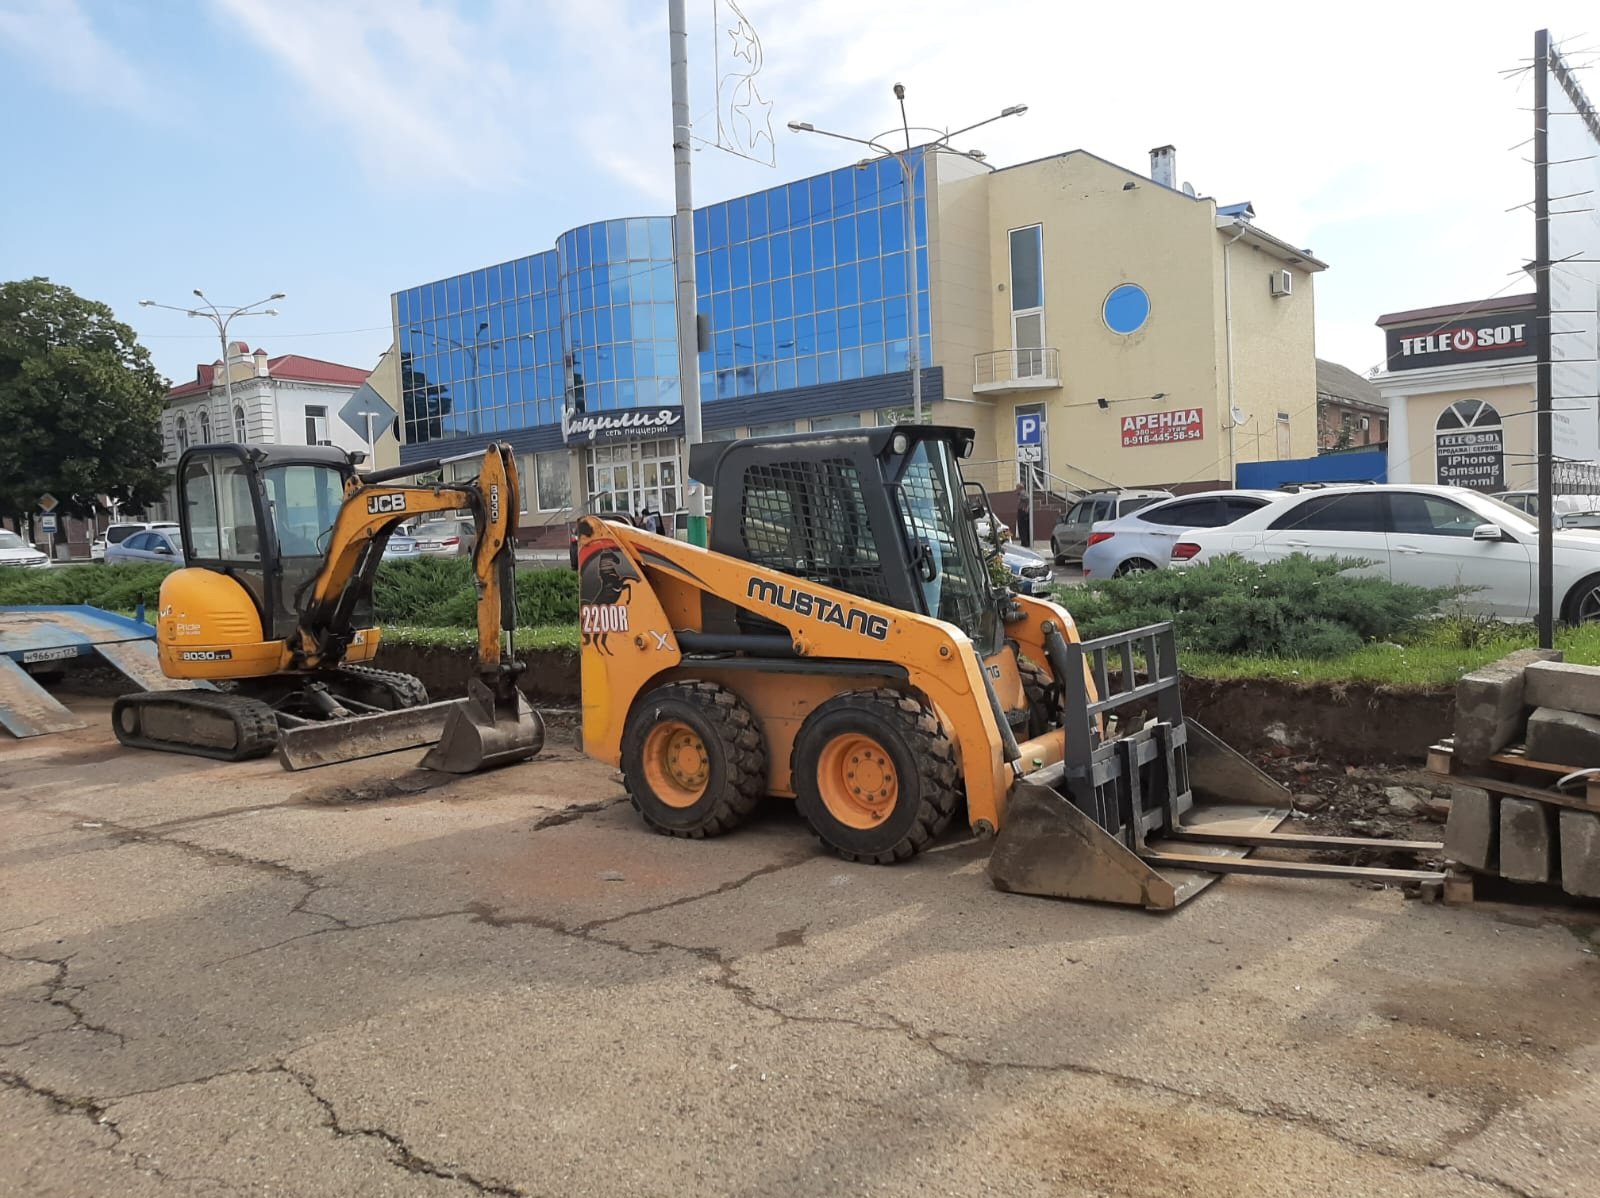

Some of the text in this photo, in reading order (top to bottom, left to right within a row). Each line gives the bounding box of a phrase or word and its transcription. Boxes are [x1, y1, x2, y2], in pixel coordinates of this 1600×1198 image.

[1123, 410, 1200, 431] АРЕНДА
[605, 424, 668, 437] сеть пиццерий
[1022, 419, 1036, 441] P
[1123, 430, 1200, 445] 8-918-445-58-54
[1438, 447, 1468, 455] ПРОДАЖА
[1448, 455, 1495, 465] iPhone
[1440, 465, 1500, 476] Samsung
[1448, 476, 1495, 487] Xiaomi
[367, 494, 406, 513] JCB
[490, 484, 499, 519] 8030
[747, 576, 889, 641] MUSTANG
[582, 605, 629, 632] 2200R
[183, 651, 215, 660] 8030
